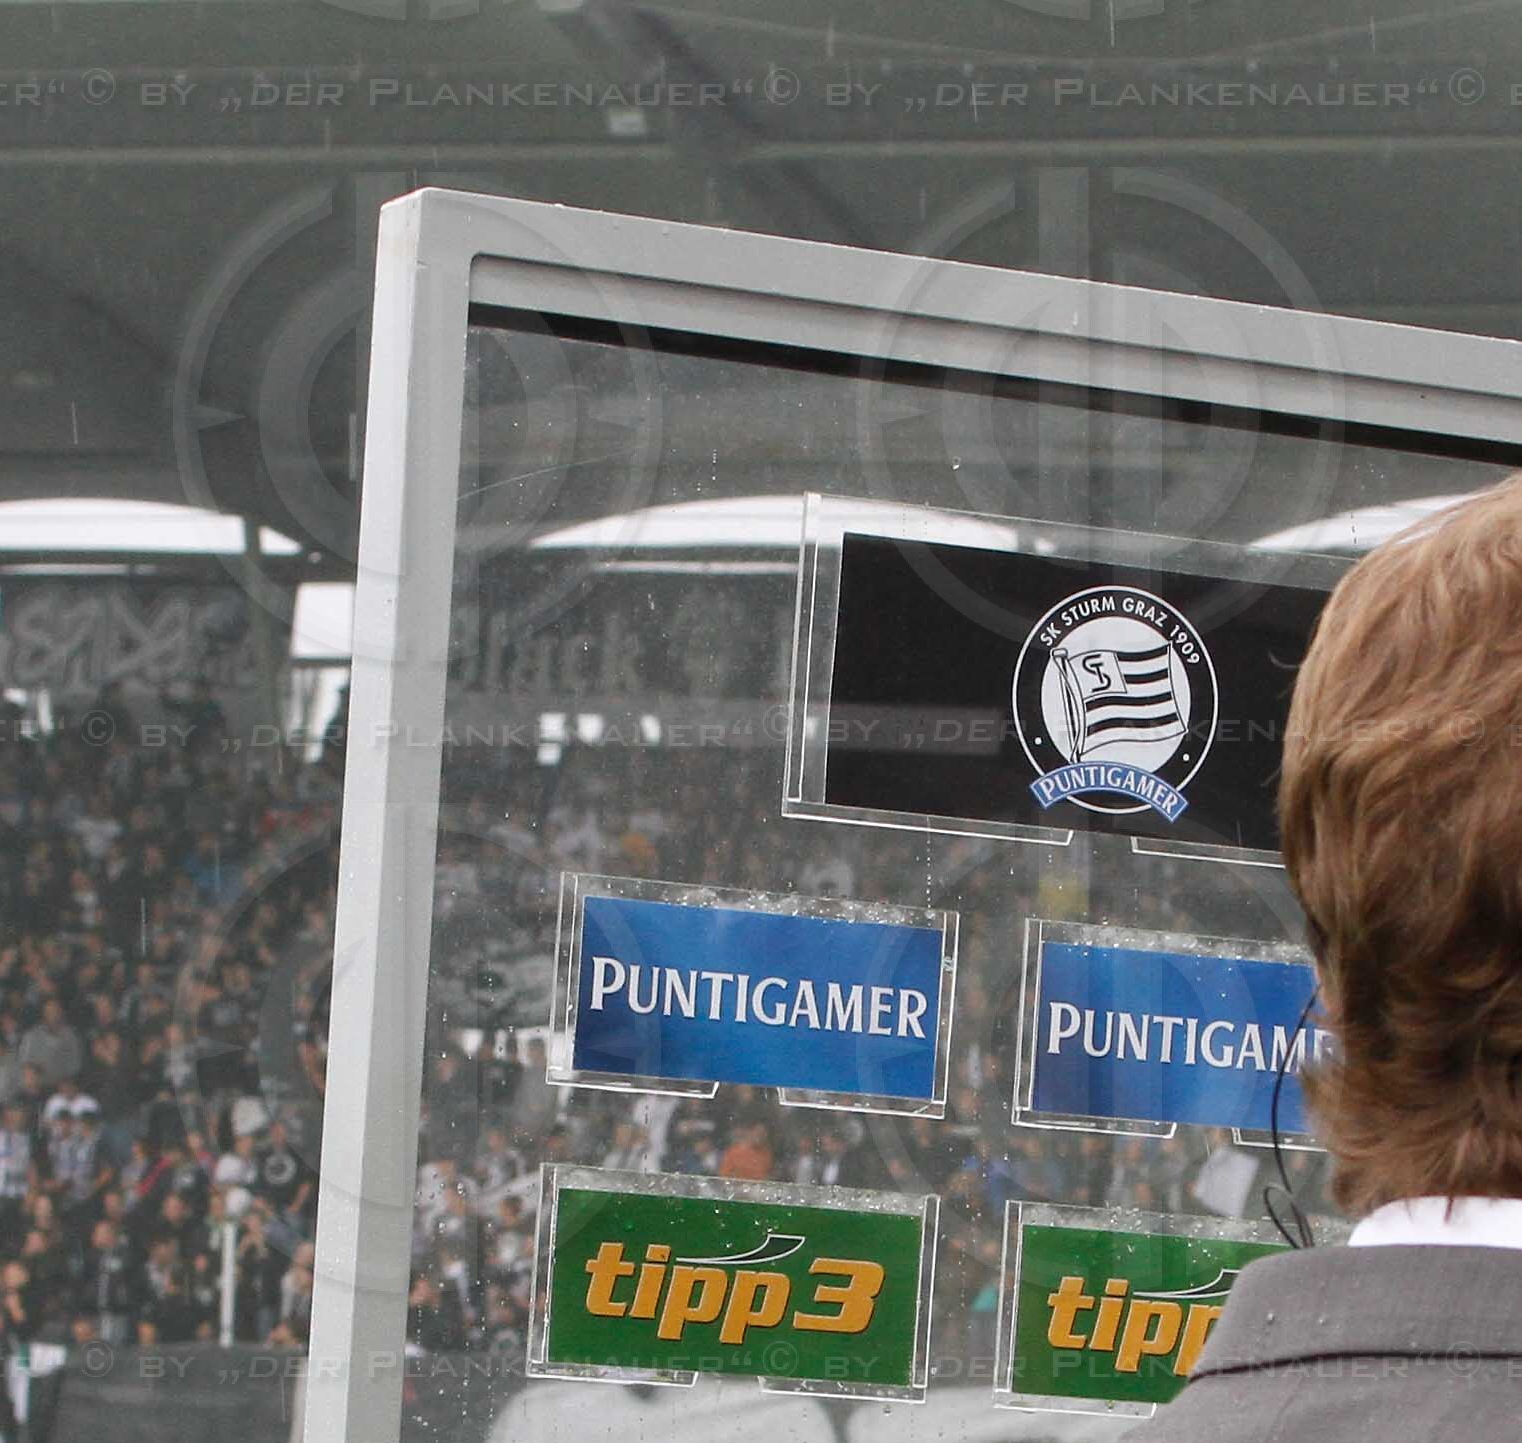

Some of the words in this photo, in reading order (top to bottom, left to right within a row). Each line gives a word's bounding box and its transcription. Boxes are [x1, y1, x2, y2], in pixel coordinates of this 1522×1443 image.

[1039, 622, 1062, 647] SK
[1061, 596, 1115, 626] STURM
[1122, 597, 1169, 628] GRAZ
[1169, 624, 1201, 664] 1909
[1038, 765, 1180, 813] PUNTIGAMER
[589, 956, 928, 1039] PUNTIGAMER
[585, 1242, 885, 1344] tipp3
